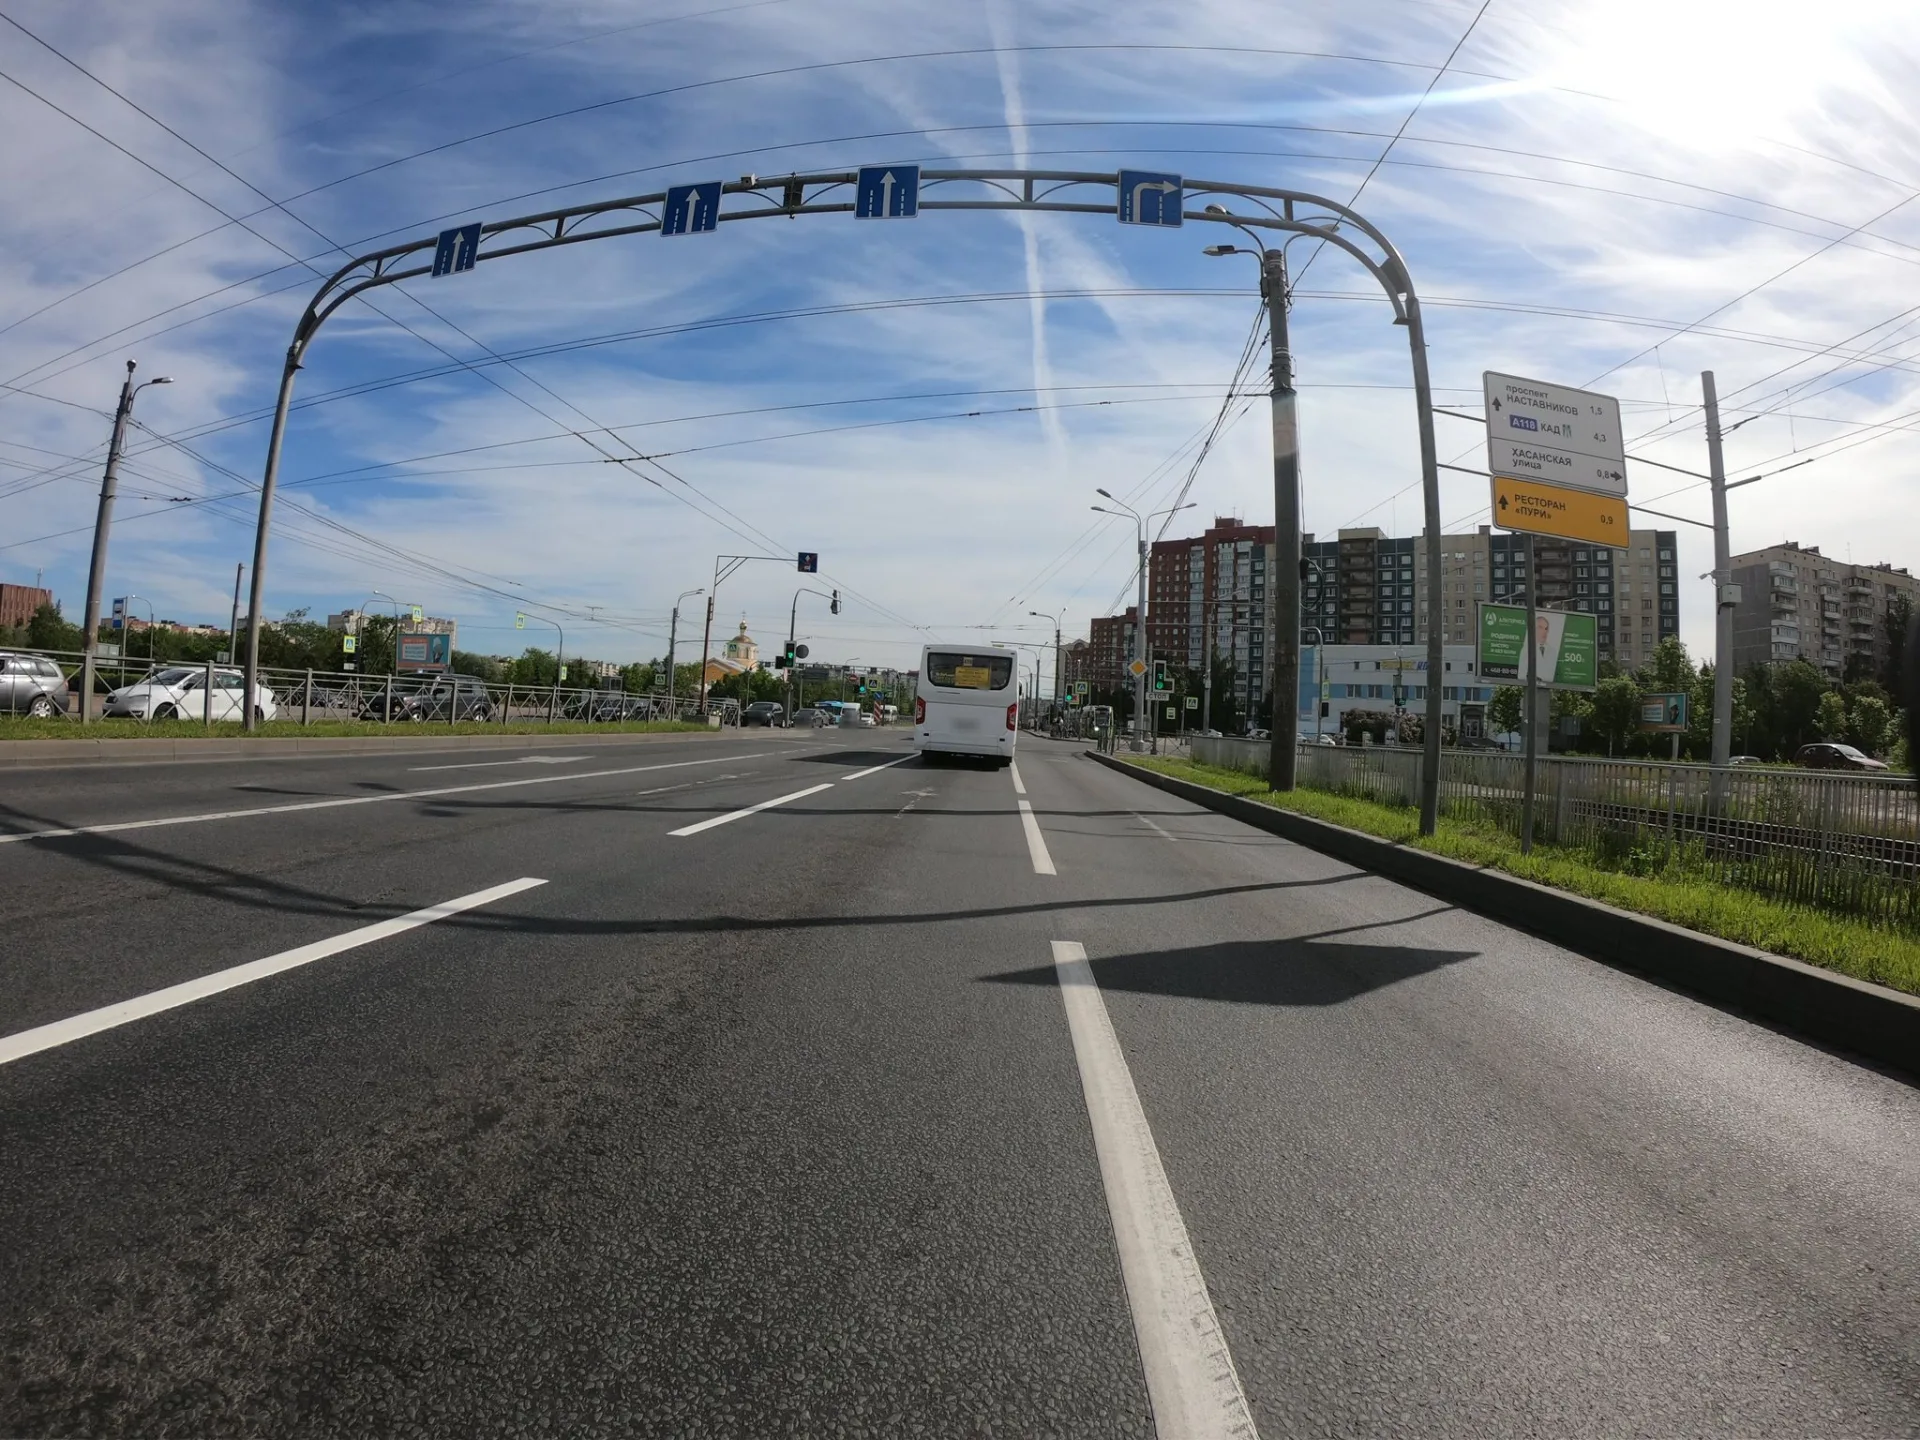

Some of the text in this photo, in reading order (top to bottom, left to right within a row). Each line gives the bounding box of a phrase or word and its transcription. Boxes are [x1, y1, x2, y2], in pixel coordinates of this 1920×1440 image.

[1506, 384, 1549, 399] проспект
[1506, 394, 1603, 416] НАСТАВНИКОВ 1,5
[1540, 423, 1561, 436] КАД
[1593, 433, 1607, 443] 4,3
[1511, 447, 1572, 467] ХАСАНСКАЯ
[1512, 458, 1542, 470] улица
[1596, 469, 1610, 479] 0,8
[1514, 494, 1566, 511] РЕСТОРАН
[1515, 506, 1614, 525] «ПУРИ» 0,9
